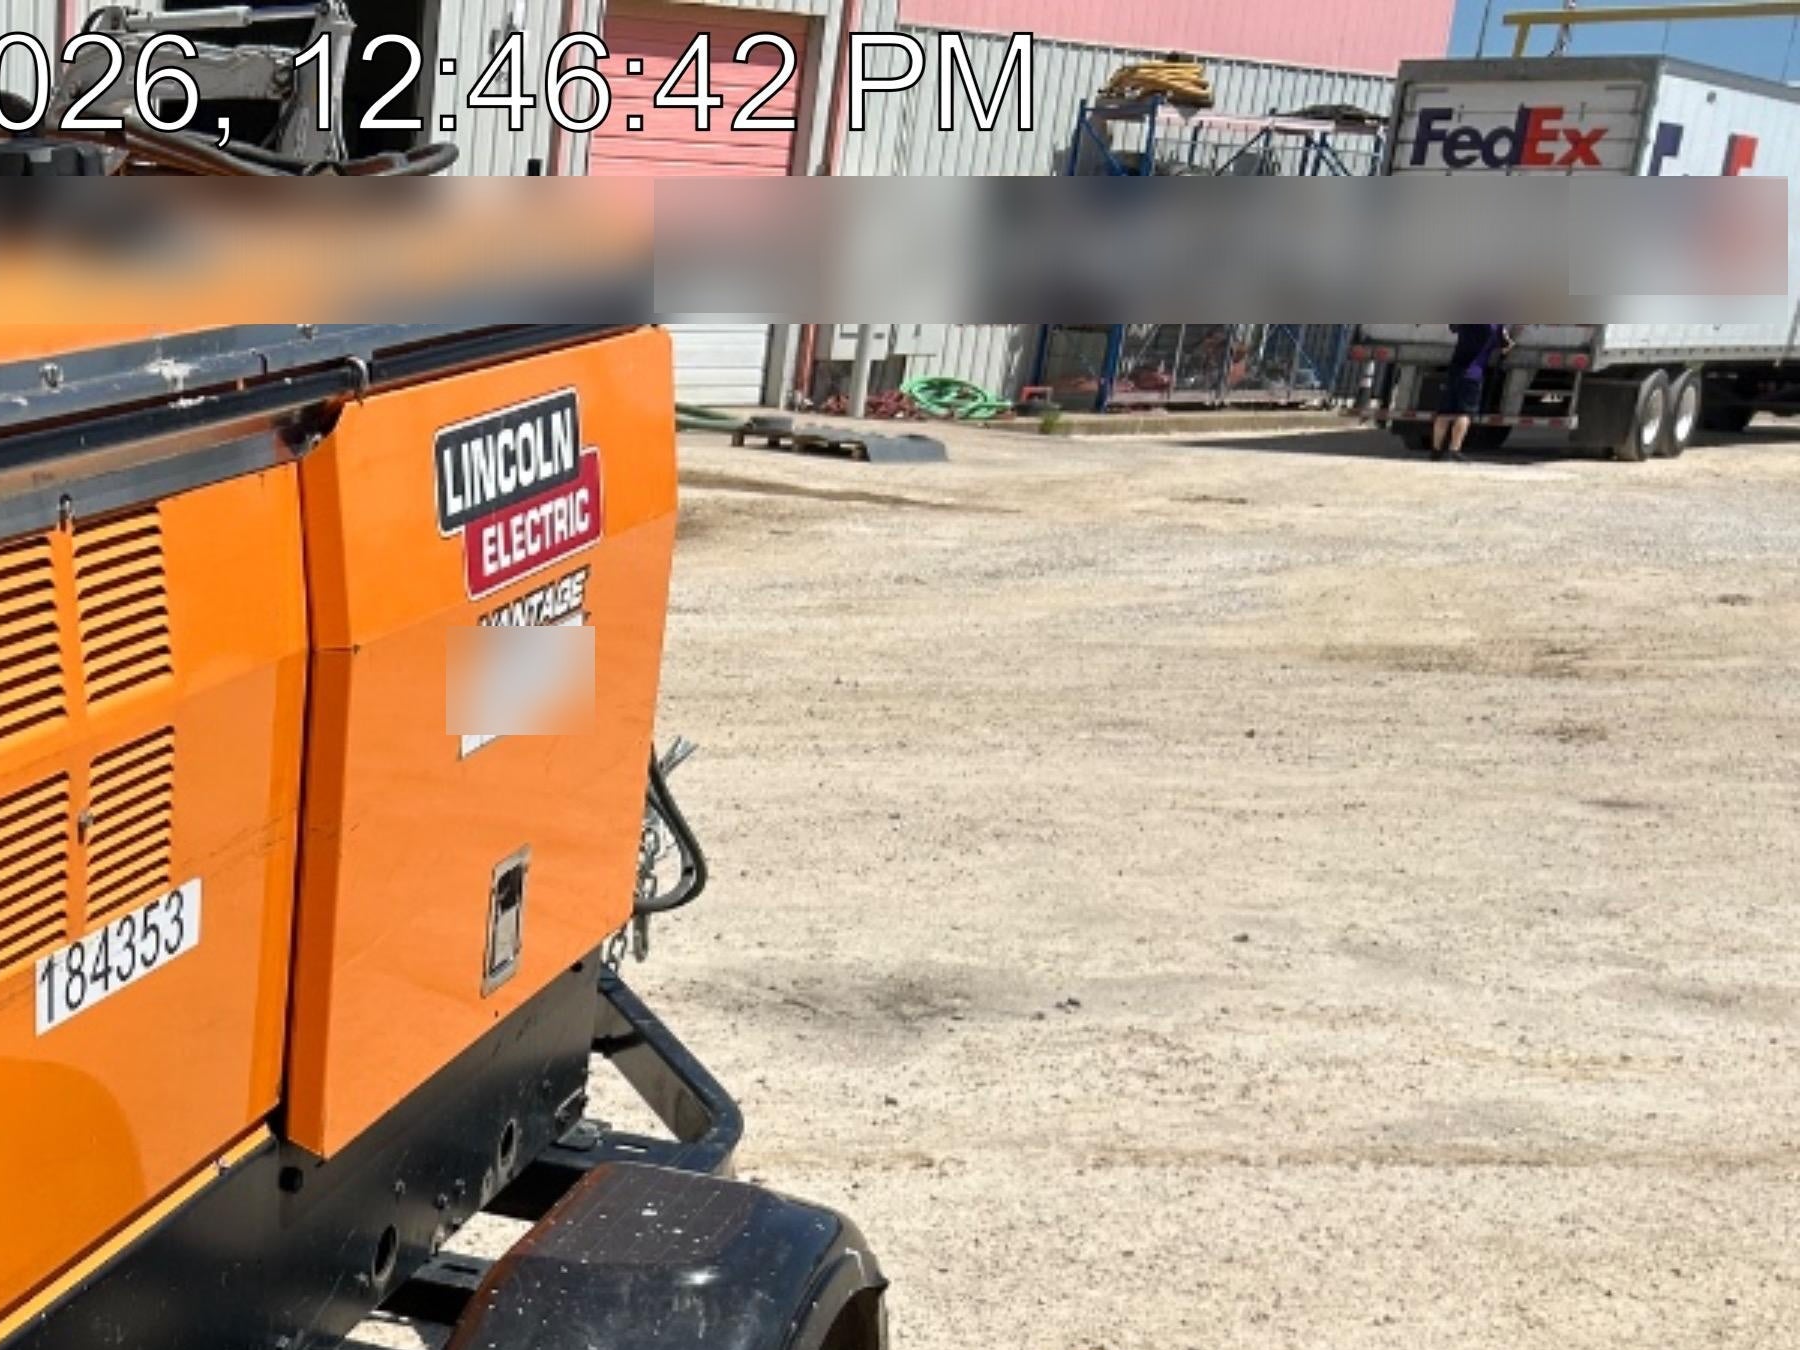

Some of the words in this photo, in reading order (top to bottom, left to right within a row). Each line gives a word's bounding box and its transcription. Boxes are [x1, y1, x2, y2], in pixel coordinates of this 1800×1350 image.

[1409, 104, 1609, 168] FedEx
[443, 407, 574, 517] LINCOLN
[482, 488, 590, 577] ELECTRIC
[40, 889, 185, 1024] 184353
